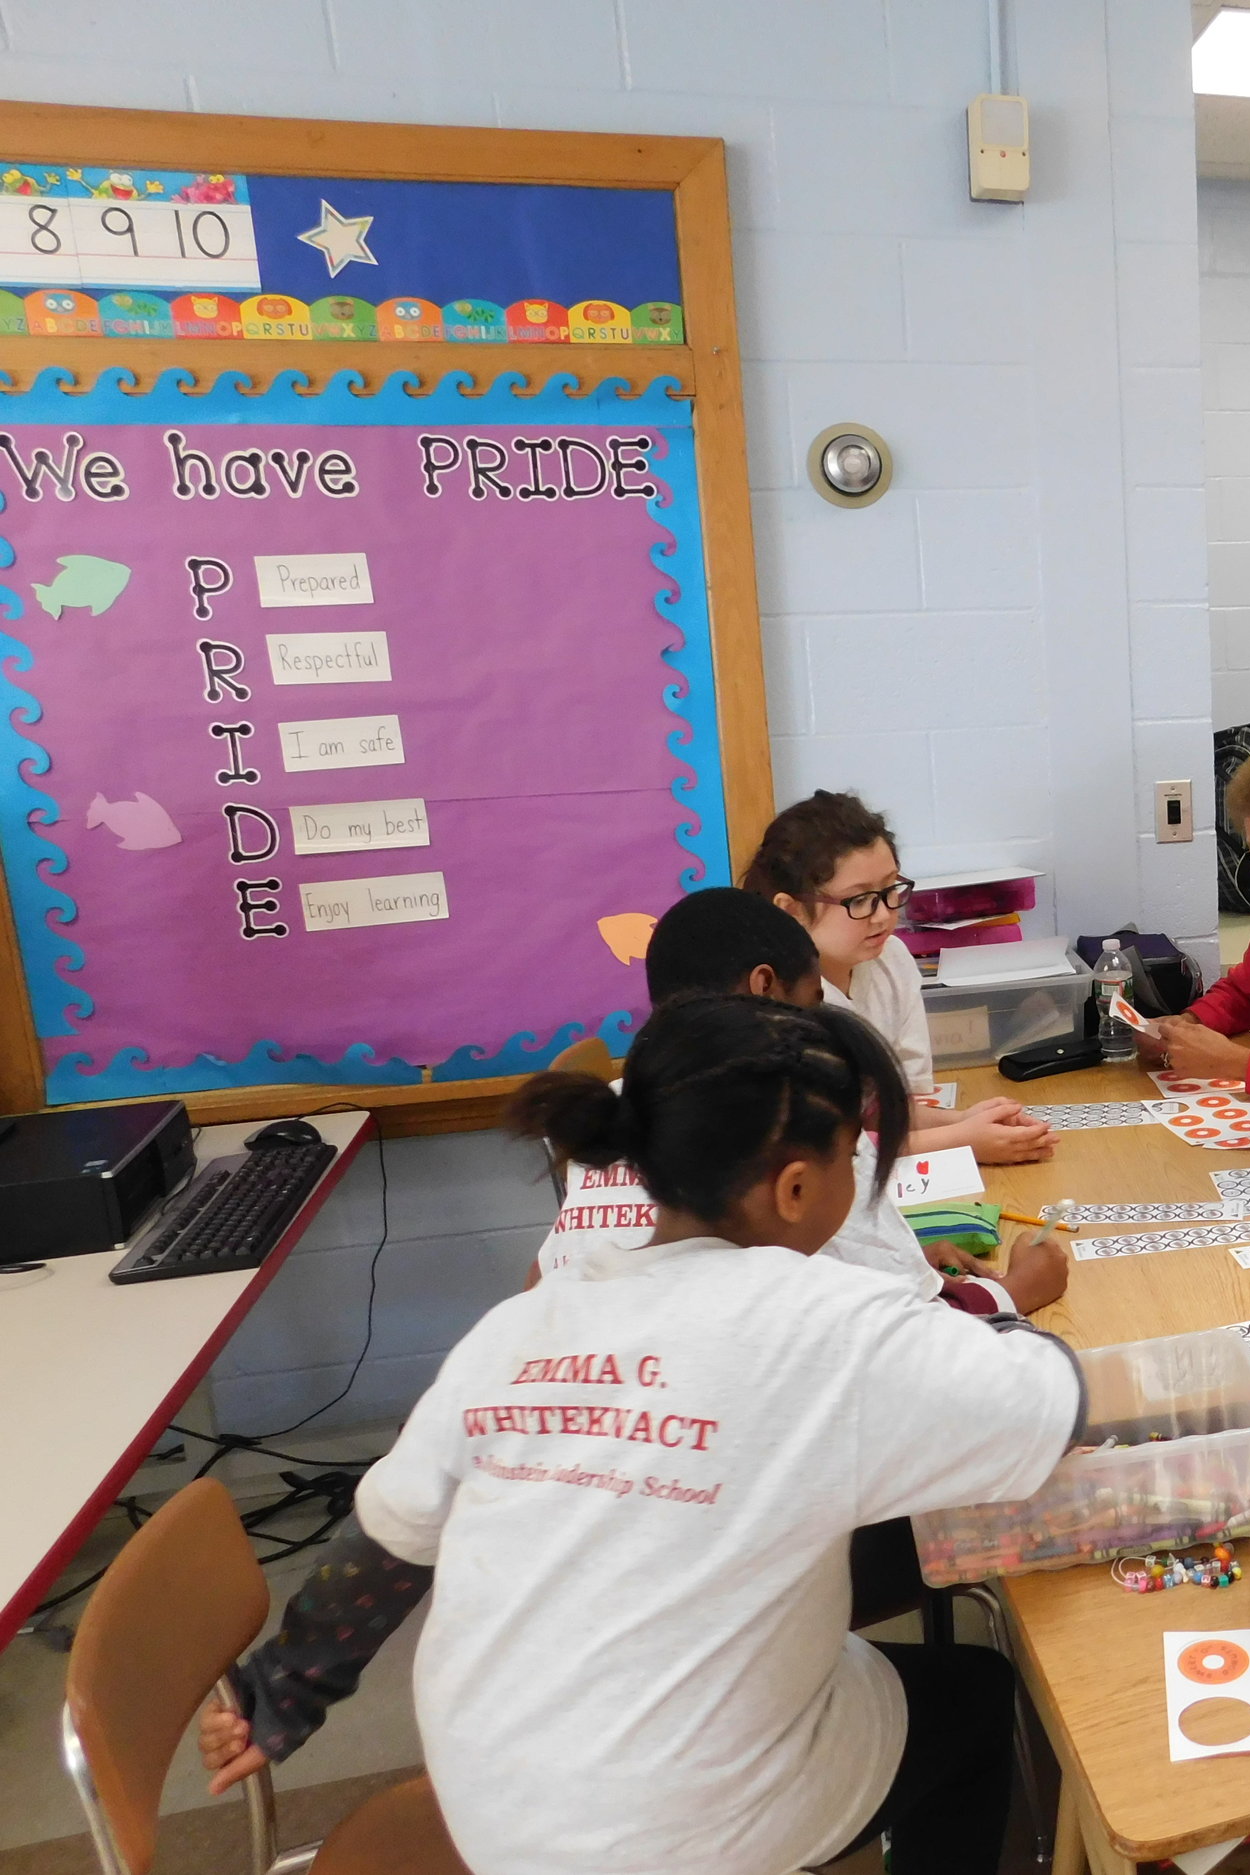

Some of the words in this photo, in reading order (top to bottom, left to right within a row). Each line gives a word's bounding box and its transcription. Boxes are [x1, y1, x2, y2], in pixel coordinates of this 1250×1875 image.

[29, 204, 61, 254] 8
[101, 207, 139, 257] 9
[174, 209, 230, 258] 10
[0, 432, 128, 500] We
[164, 430, 359, 499] have
[418, 433, 657, 500] PRIDE
[276, 563, 361, 599] Prepared
[277, 641, 379, 678] Respectful
[288, 730, 309, 760] I
[318, 740, 345, 757] am
[359, 725, 397, 755] safe
[303, 814, 333, 841] Do
[348, 821, 373, 844] my
[383, 808, 424, 836] best
[305, 892, 352, 925] Enjoy
[368, 887, 441, 918] learning
[580, 1163, 645, 1190] EMM
[510, 1353, 626, 1385] EMMA
[638, 1355, 669, 1389] G.
[640, 1475, 724, 1505] School
